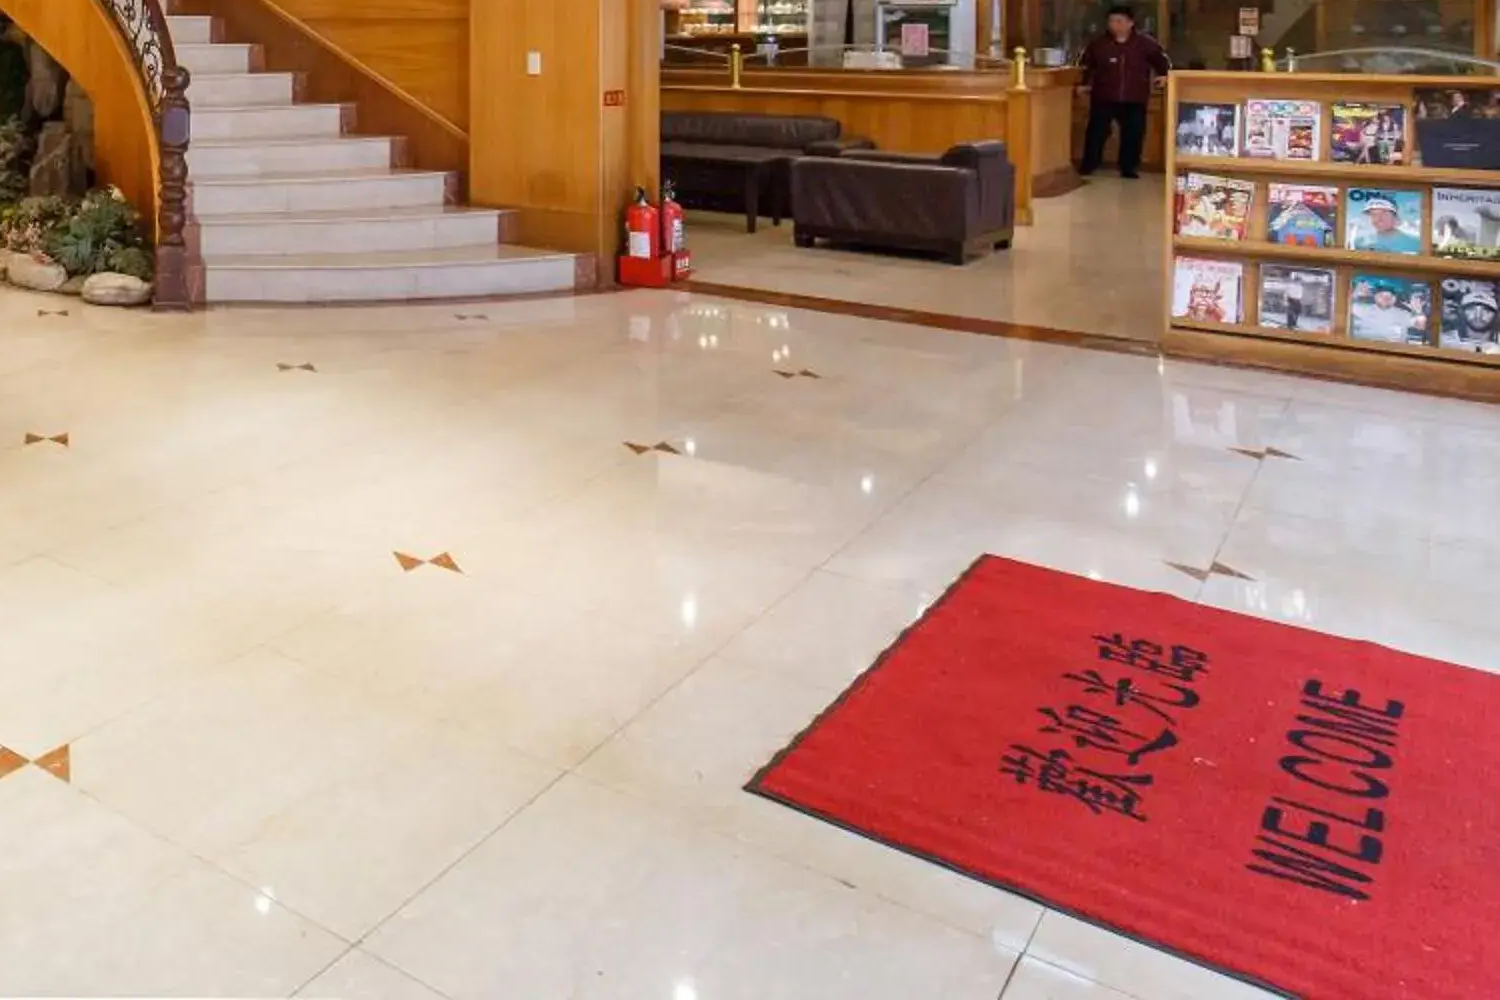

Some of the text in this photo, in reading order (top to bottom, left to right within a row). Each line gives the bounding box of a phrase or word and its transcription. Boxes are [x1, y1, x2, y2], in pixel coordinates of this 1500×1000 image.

[999, 633, 1209, 822] 歡迎光臨
[1244, 679, 1405, 900] WELCOME
